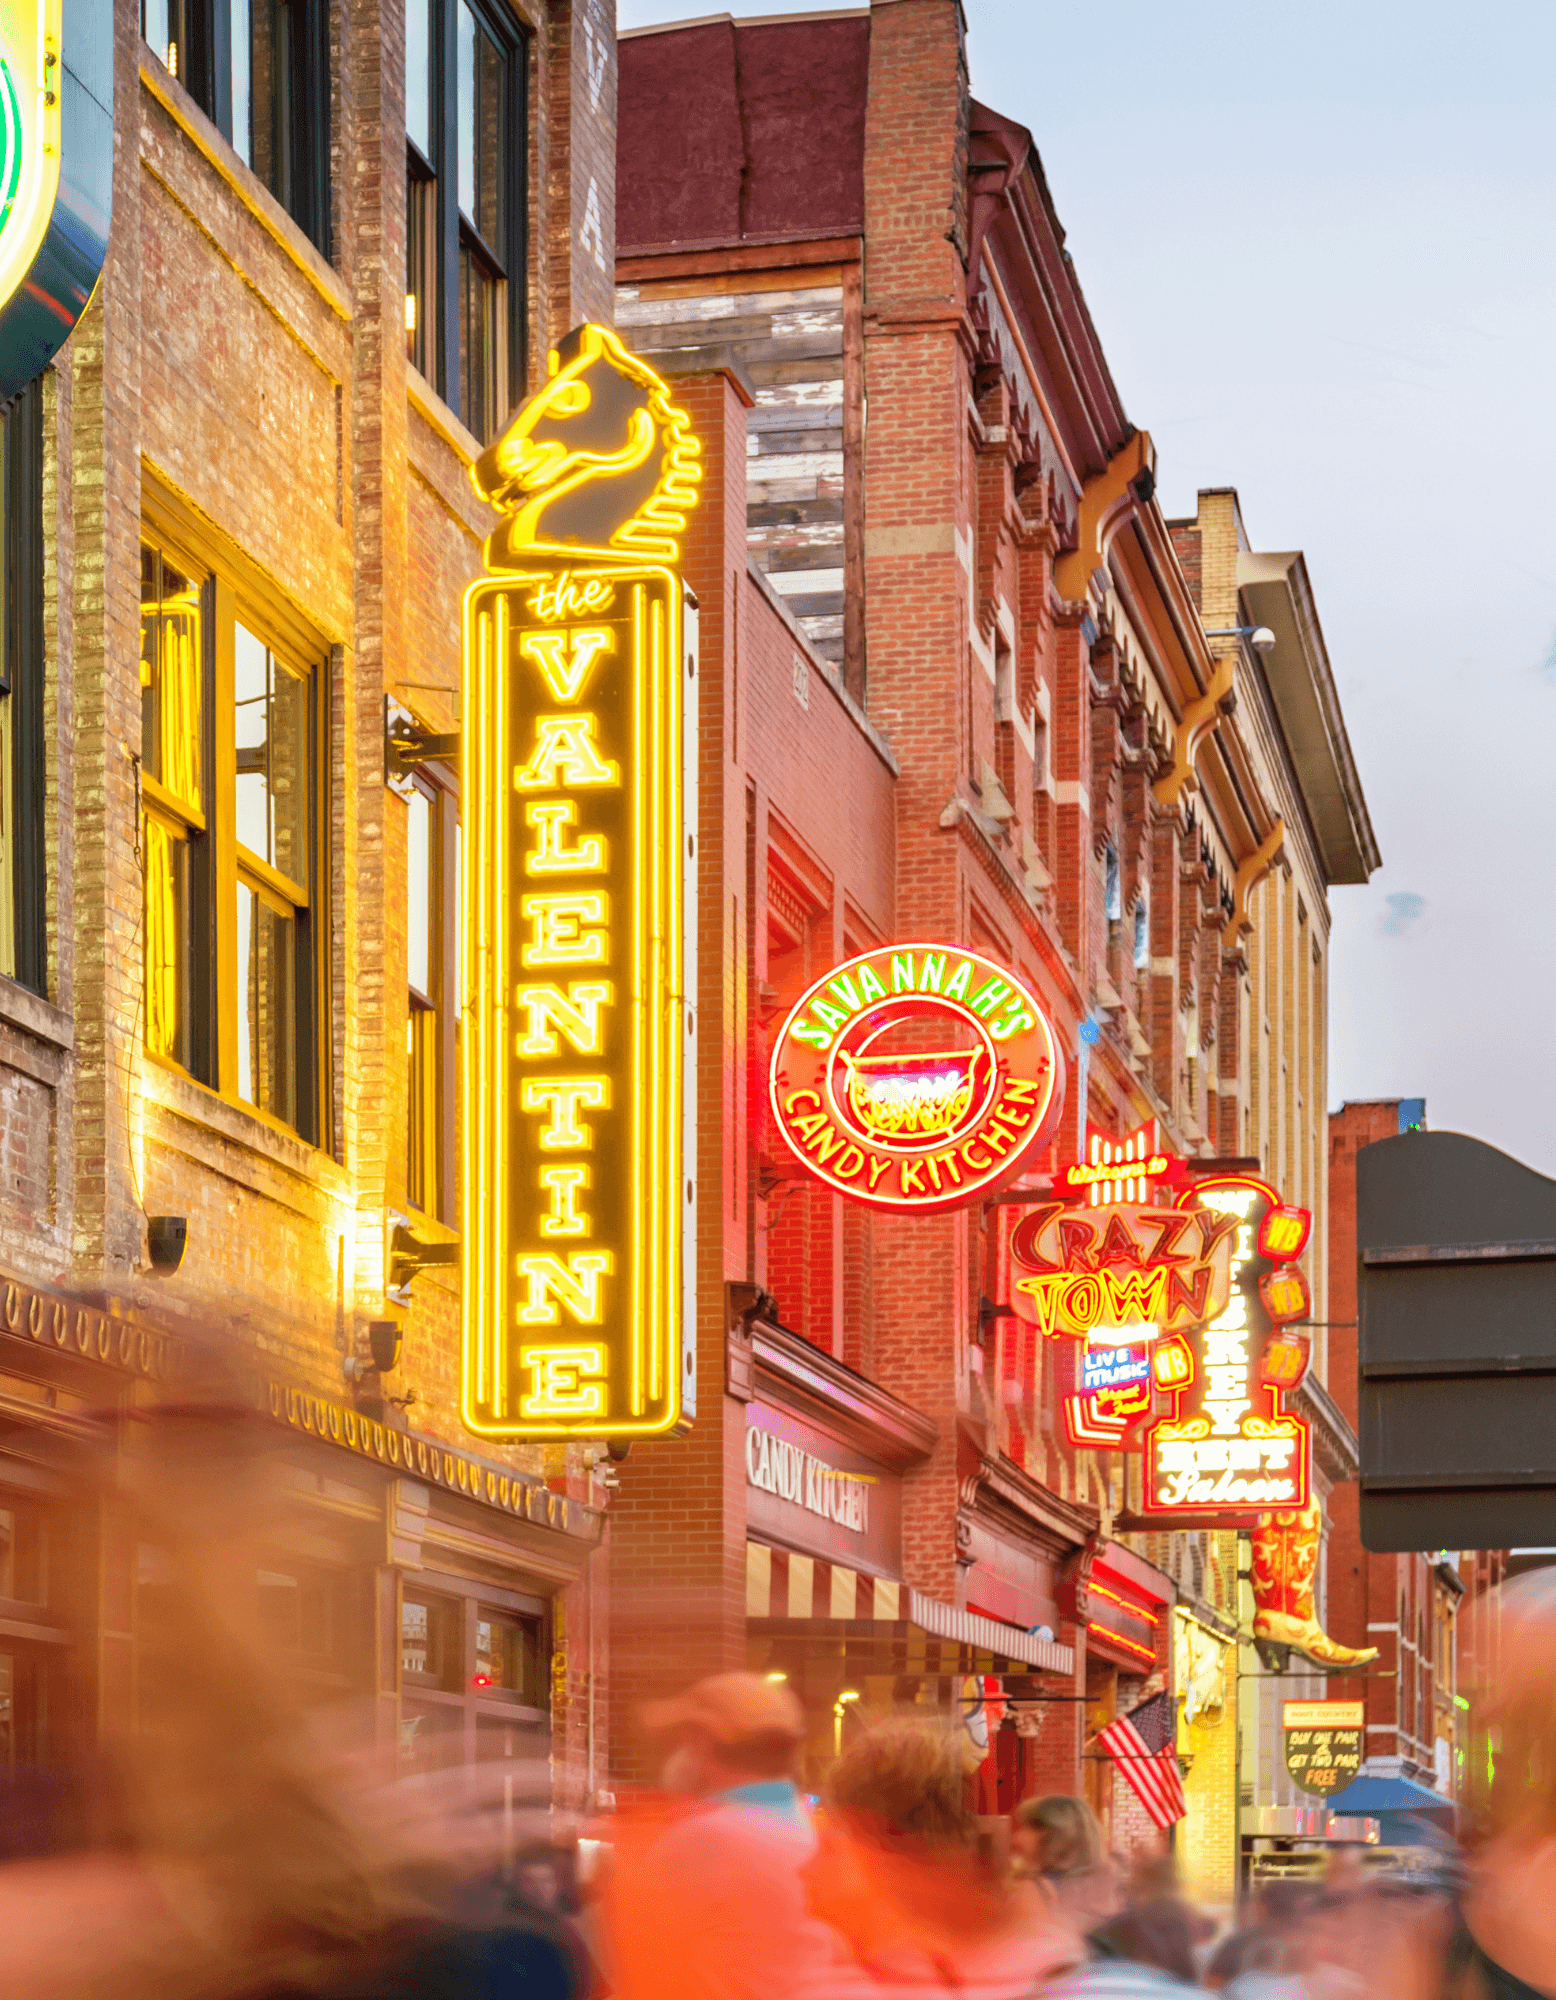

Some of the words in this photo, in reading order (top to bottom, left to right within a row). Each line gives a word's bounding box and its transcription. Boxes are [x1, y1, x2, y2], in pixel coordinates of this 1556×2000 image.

[526, 570, 615, 623] the
[788, 951, 1035, 1050] SAVANNAH'S
[514, 626, 623, 1418] VALENTINE
[785, 1089, 892, 1188] CANDY
[901, 1076, 1039, 1194] KITCHEN
[1067, 1161, 1147, 1185] Welcome
[1147, 1156, 1168, 1175] to
[1011, 1203, 1244, 1272] CRAZY
[1267, 1217, 1302, 1251] WB
[1016, 1265, 1215, 1336] TOWN
[1154, 1347, 1188, 1382] WB
[1110, 1395, 1150, 1417] Food
[745, 1425, 804, 1505] CANDY
[805, 1454, 870, 1535] KITCHEN
[1158, 1469, 1296, 1505] Saloon
[1288, 1731, 1312, 1745] BUY
[1312, 1731, 1334, 1745] ONE
[1334, 1731, 1359, 1745] PAIR
[1288, 1754, 1309, 1768] GET
[1310, 1754, 1333, 1767] TWO
[1333, 1754, 1360, 1768] PAIR
[1304, 1768, 1338, 1787] FREE
